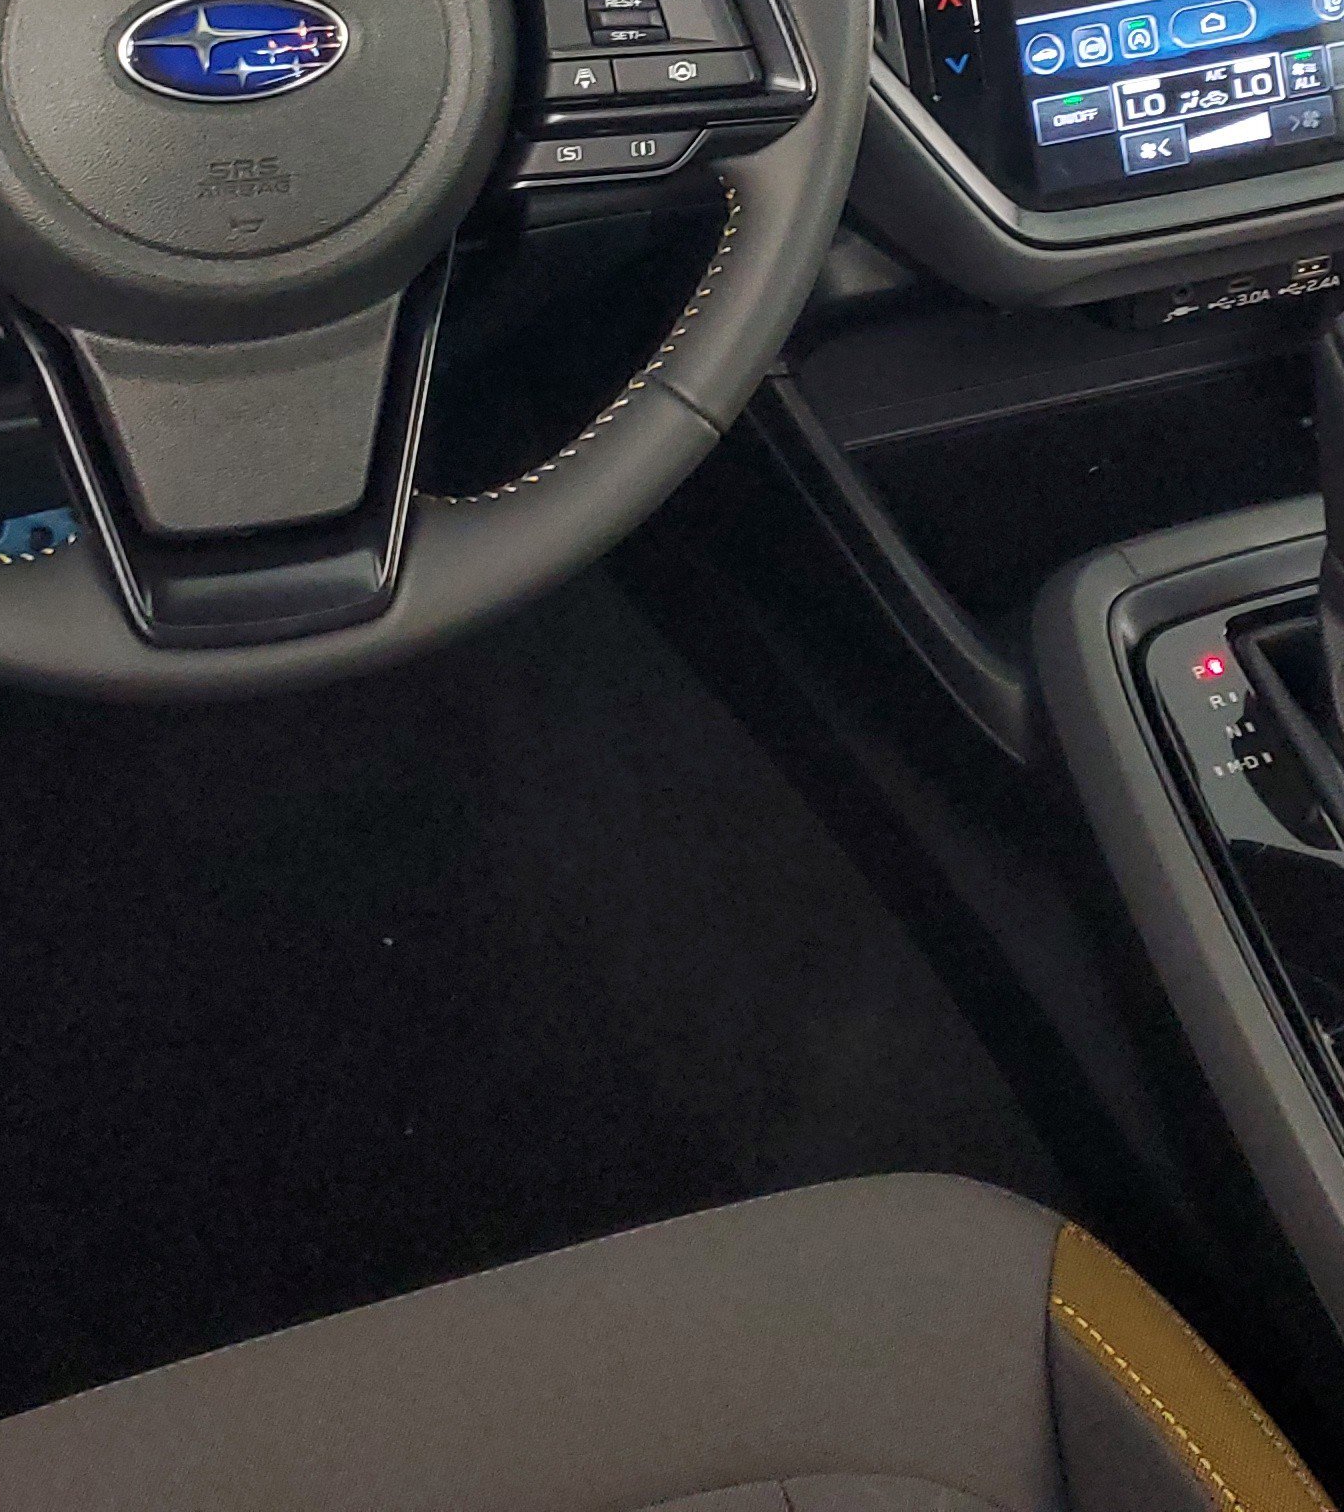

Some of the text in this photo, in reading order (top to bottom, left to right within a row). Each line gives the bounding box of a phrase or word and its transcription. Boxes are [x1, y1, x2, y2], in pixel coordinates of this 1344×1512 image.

[1233, 72, 1273, 99] LO
[1294, 75, 1321, 90] ALL
[1126, 92, 1167, 120] LO
[1209, 694, 1227, 710] R
